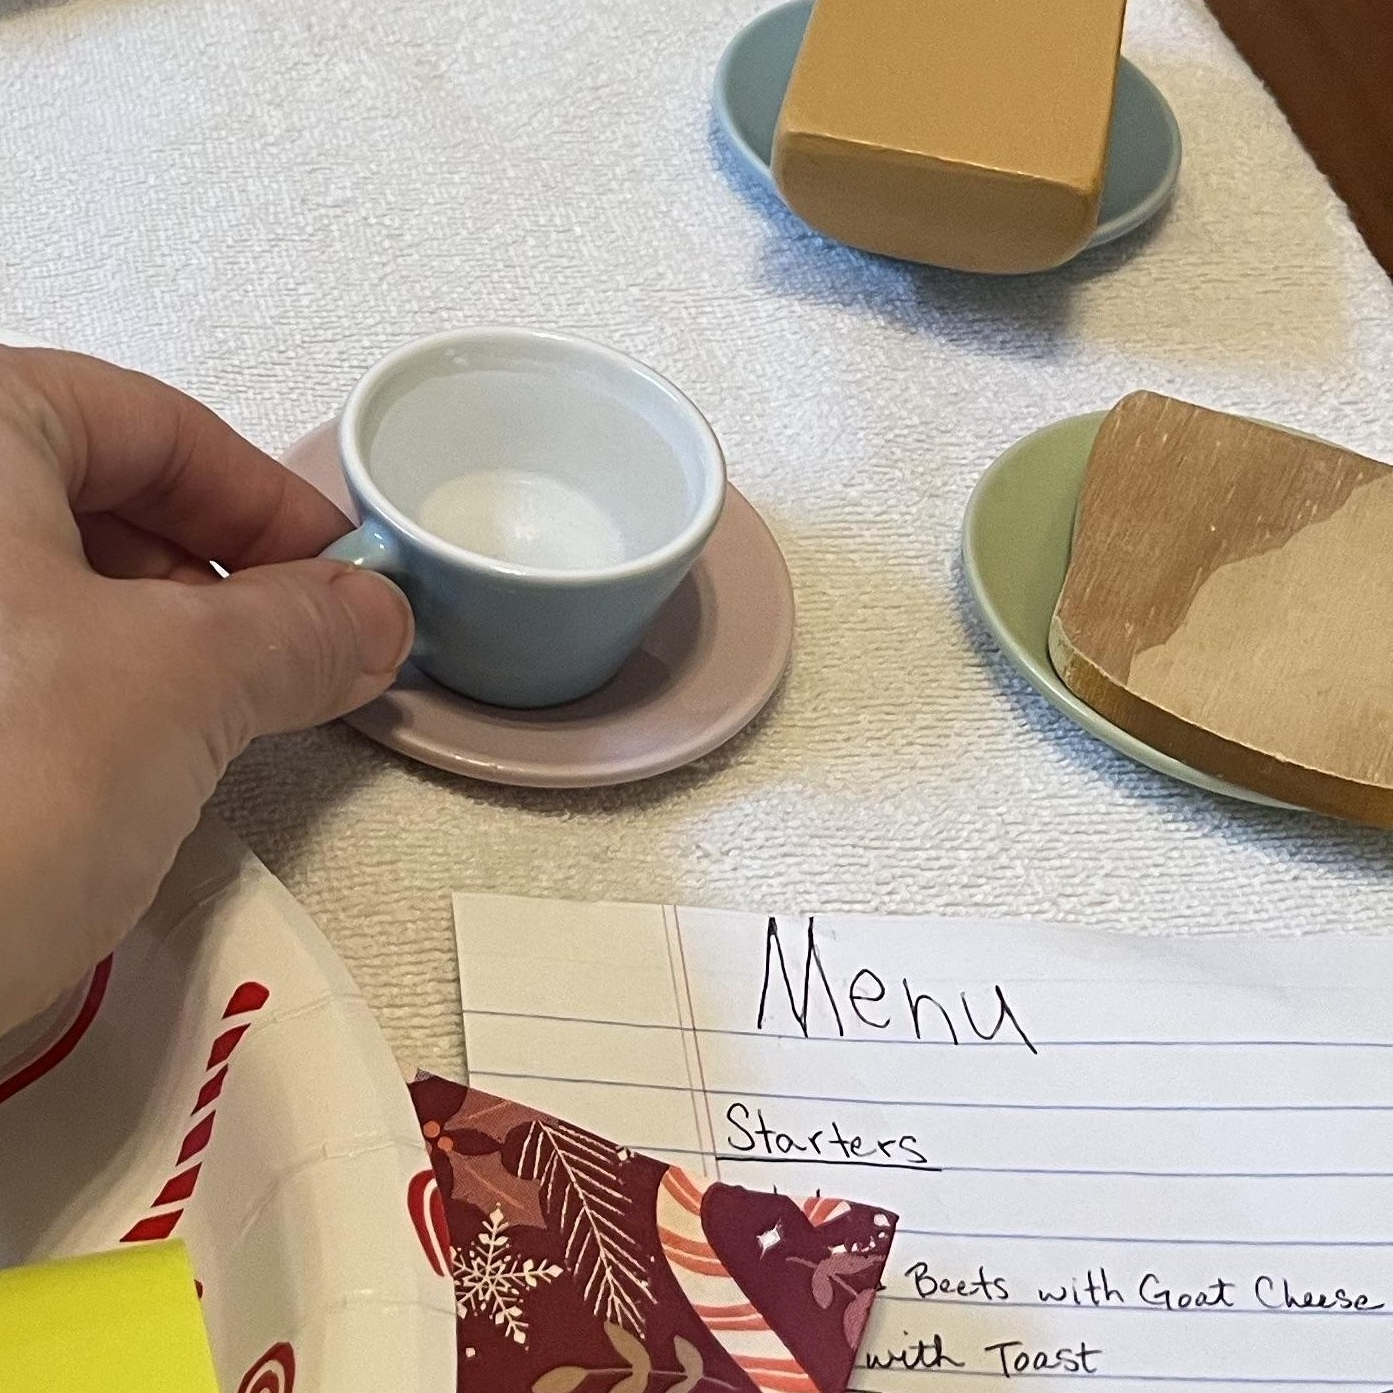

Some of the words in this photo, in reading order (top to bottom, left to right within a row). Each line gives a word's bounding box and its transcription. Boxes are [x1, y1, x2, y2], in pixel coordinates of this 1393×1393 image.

[758, 917, 1037, 1054] Menu
[727, 1103, 927, 1163] Starters
[905, 1262, 1008, 1300] Beets
[1038, 1267, 1125, 1306] with
[1138, 1273, 1235, 1310] Goat
[1255, 1276, 1385, 1311] Cheese
[866, 1330, 965, 1369] with
[984, 1341, 1102, 1378] Toast
